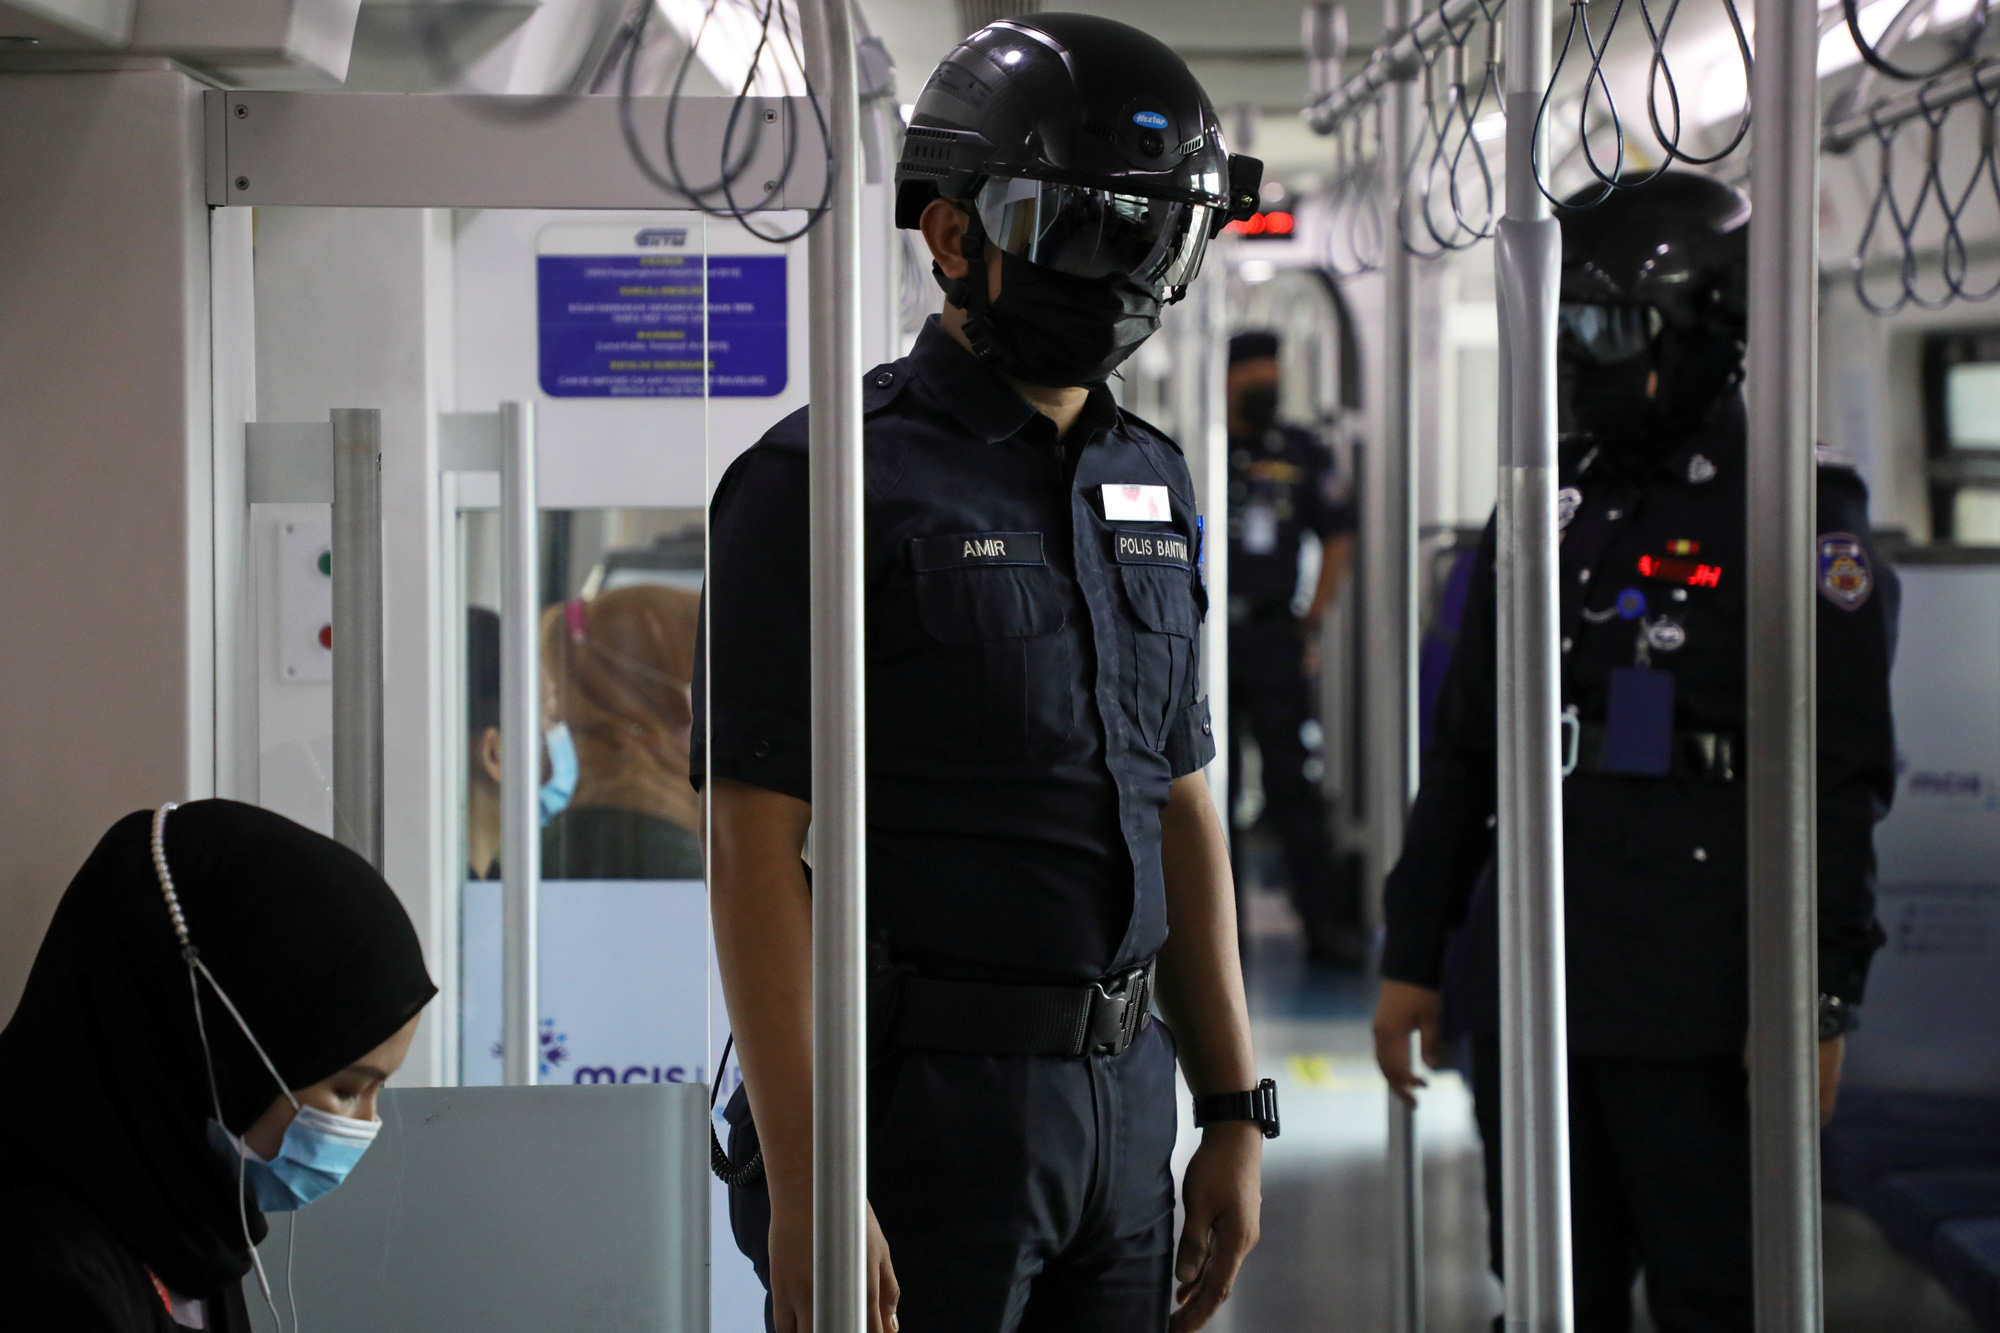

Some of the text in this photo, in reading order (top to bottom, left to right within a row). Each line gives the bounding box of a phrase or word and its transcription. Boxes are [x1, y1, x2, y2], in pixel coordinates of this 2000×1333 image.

[1136, 114, 1165, 125] Hextar
[963, 539, 1006, 558] AMIR
[1120, 537, 1153, 556] POLIS
